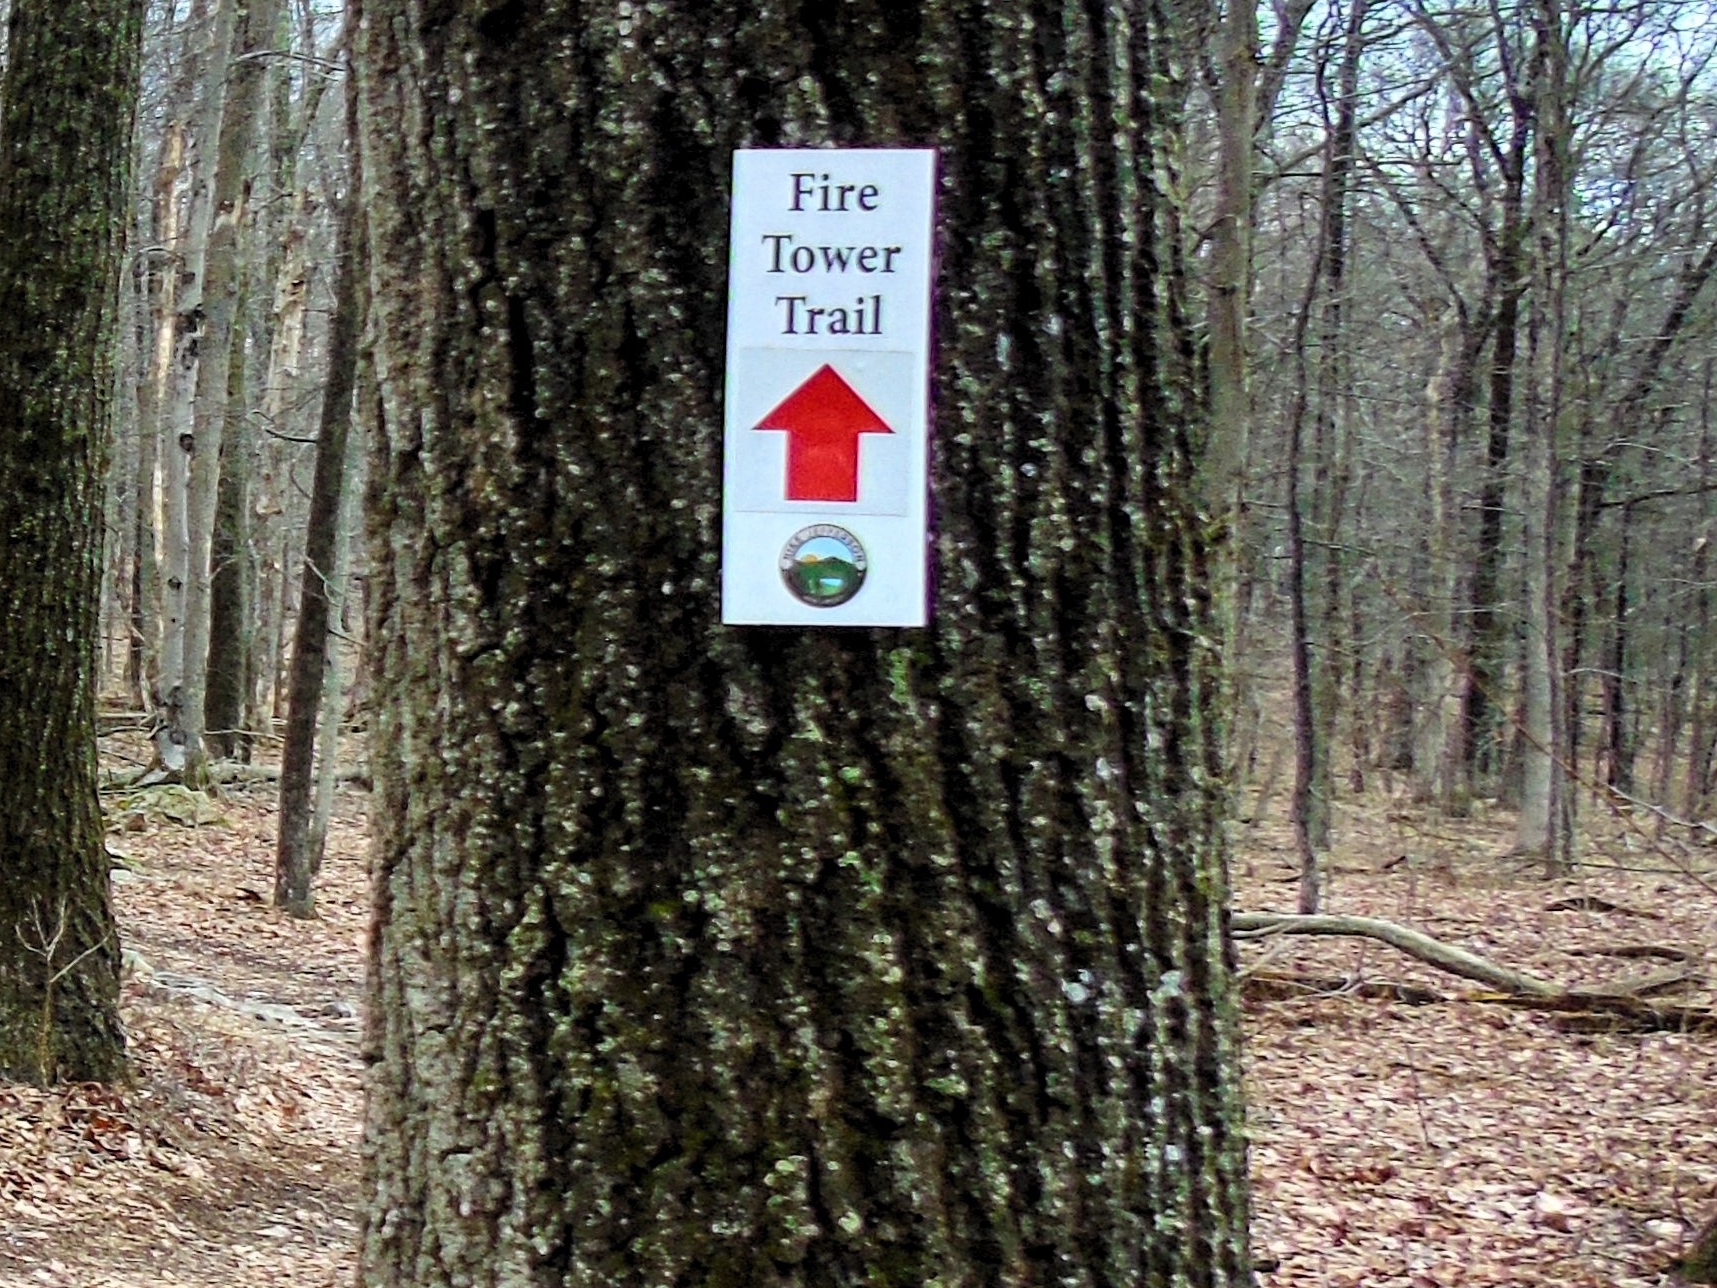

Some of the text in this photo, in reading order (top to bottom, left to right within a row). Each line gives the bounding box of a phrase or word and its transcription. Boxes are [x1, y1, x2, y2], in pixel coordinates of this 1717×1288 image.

[788, 173, 880, 212] Fire
[762, 234, 902, 274] Tower
[775, 294, 883, 335] Trail
